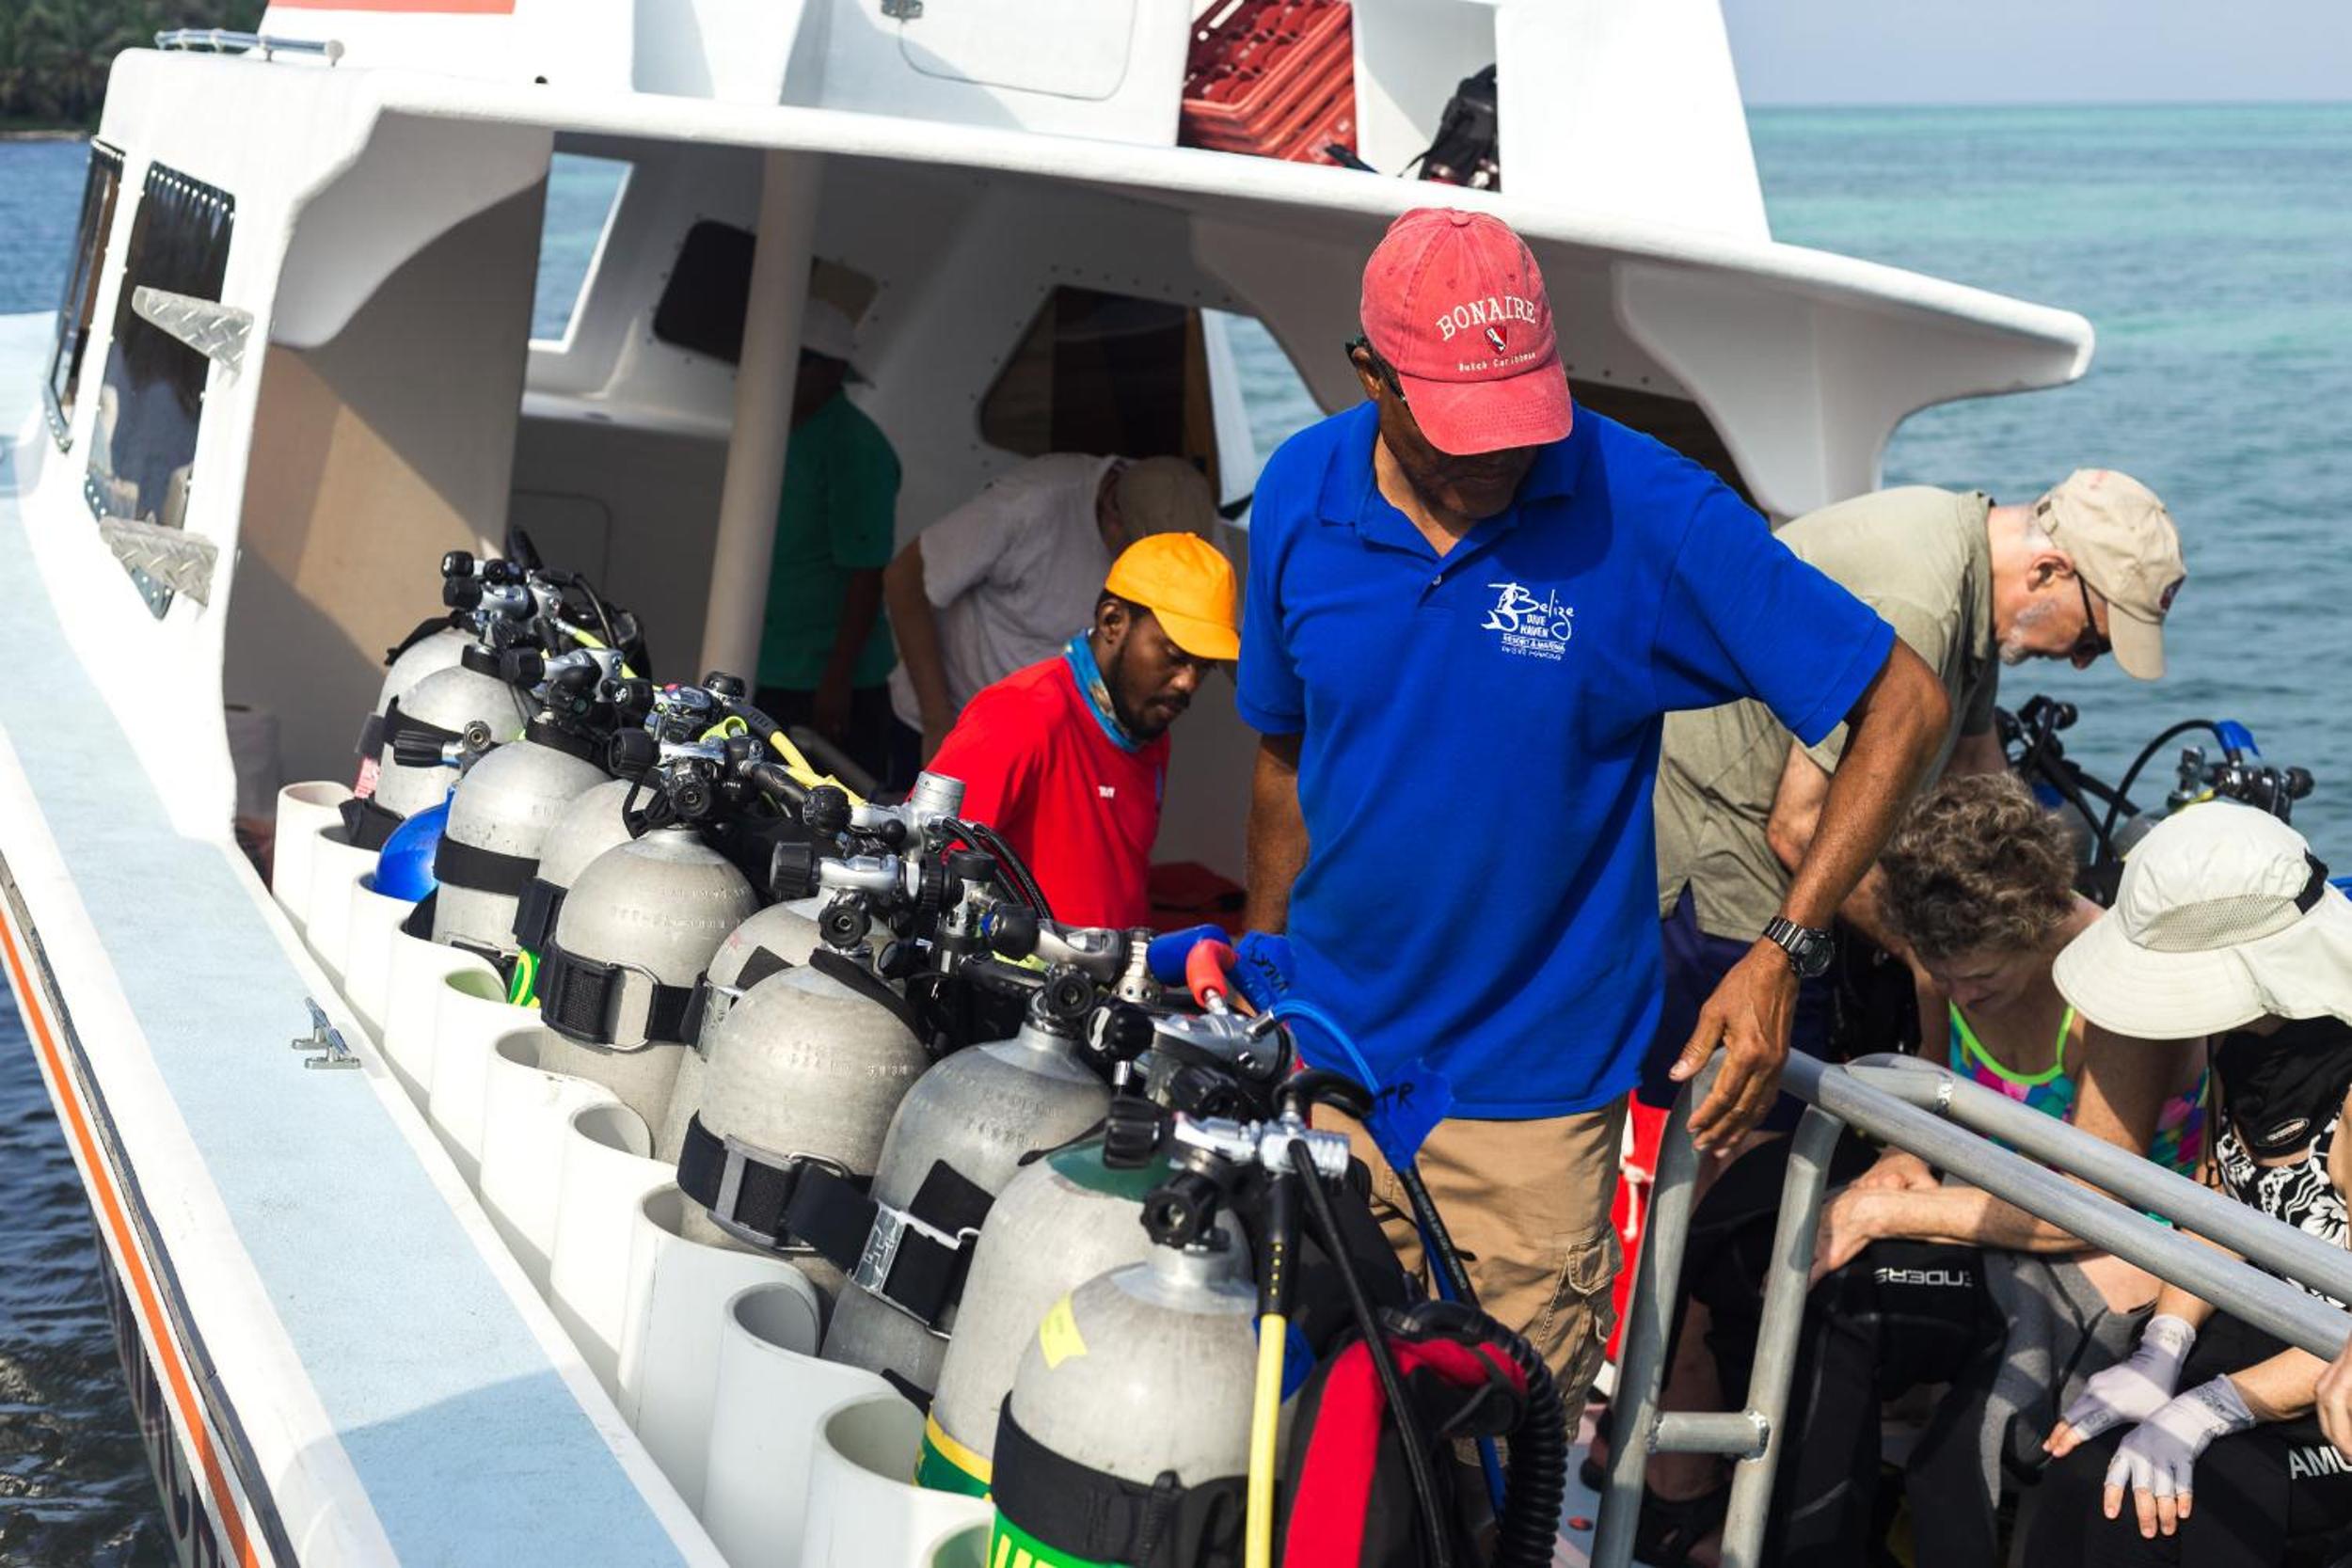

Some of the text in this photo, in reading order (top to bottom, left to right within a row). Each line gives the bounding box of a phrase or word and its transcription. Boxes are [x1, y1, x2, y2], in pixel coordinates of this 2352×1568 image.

[1436, 296, 1535, 341] BONAIRE
[1459, 360, 1487, 372] Dutch
[1483, 582, 1575, 641] Belize
